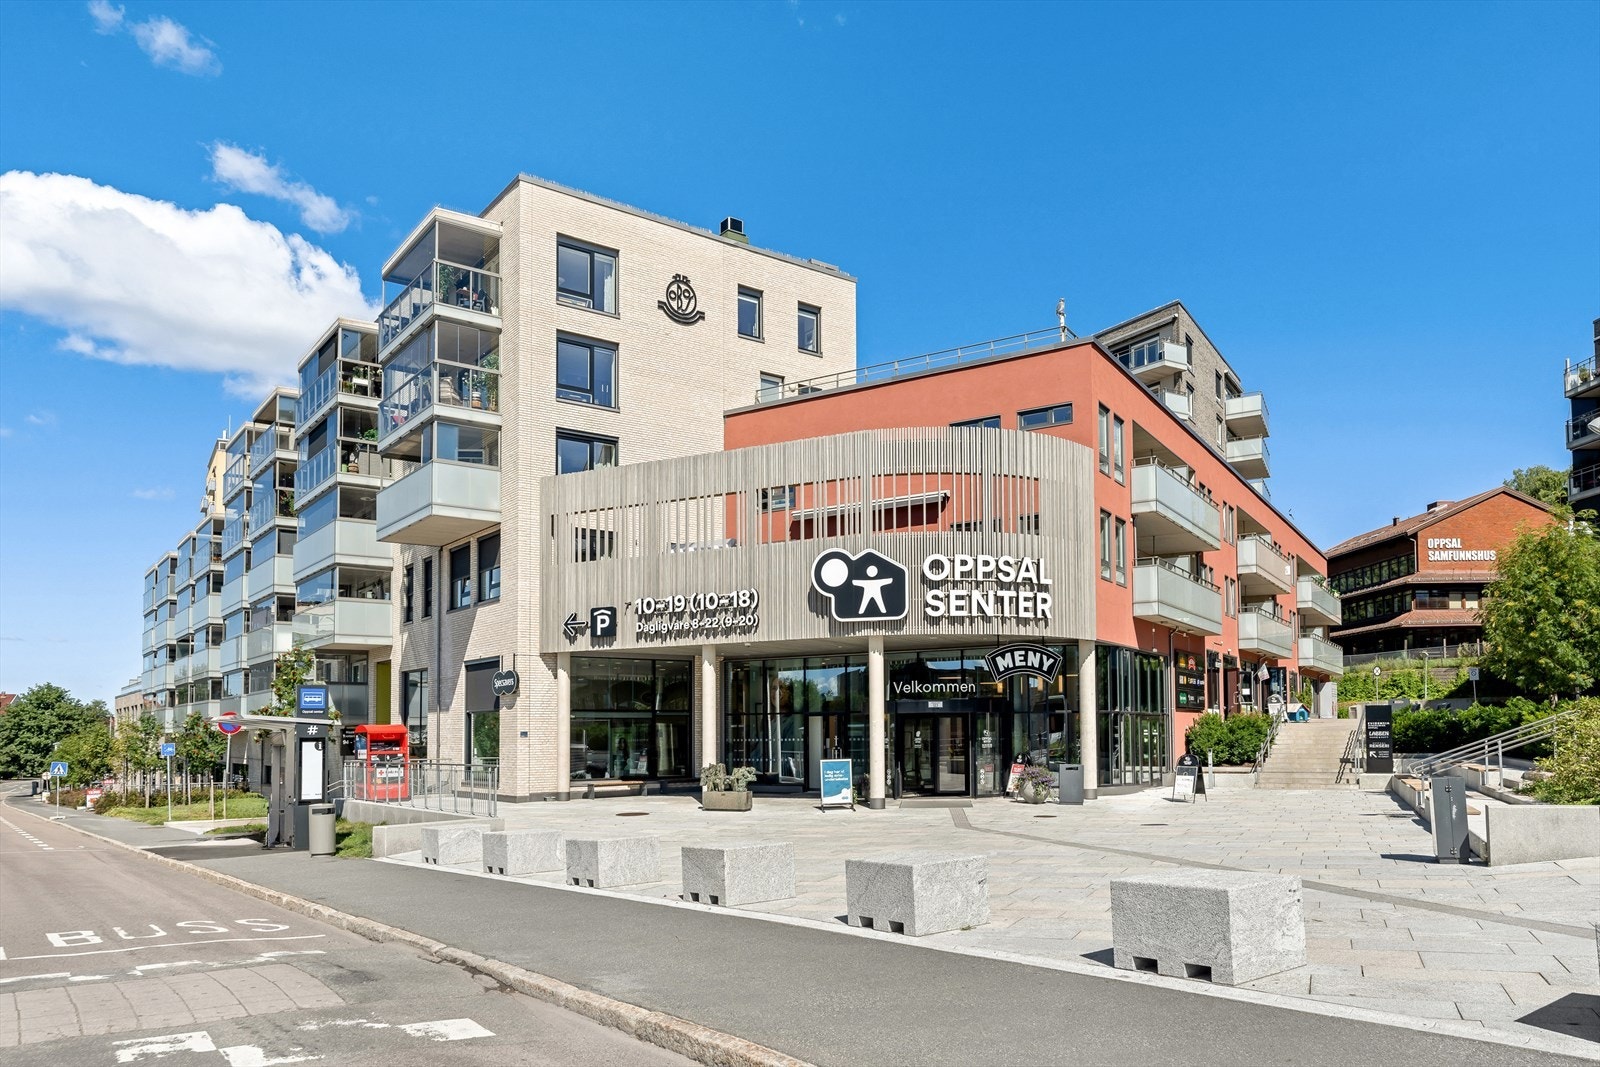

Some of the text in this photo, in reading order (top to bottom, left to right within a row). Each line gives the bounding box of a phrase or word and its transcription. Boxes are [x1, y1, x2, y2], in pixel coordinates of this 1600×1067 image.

[1427, 537, 1463, 549] OPPSAL
[1428, 550, 1497, 561] SAMFUNNSHUS
[922, 553, 1053, 585] OPPSAL
[925, 588, 1053, 619] SENTER
[596, 614, 610, 636] P
[636, 620, 690, 634] Dagligvare
[995, 650, 1055, 672] MENY
[494, 677, 514, 689] Specsavers
[893, 680, 976, 694] Velkommen
[45, 918, 290, 947] BUSS
